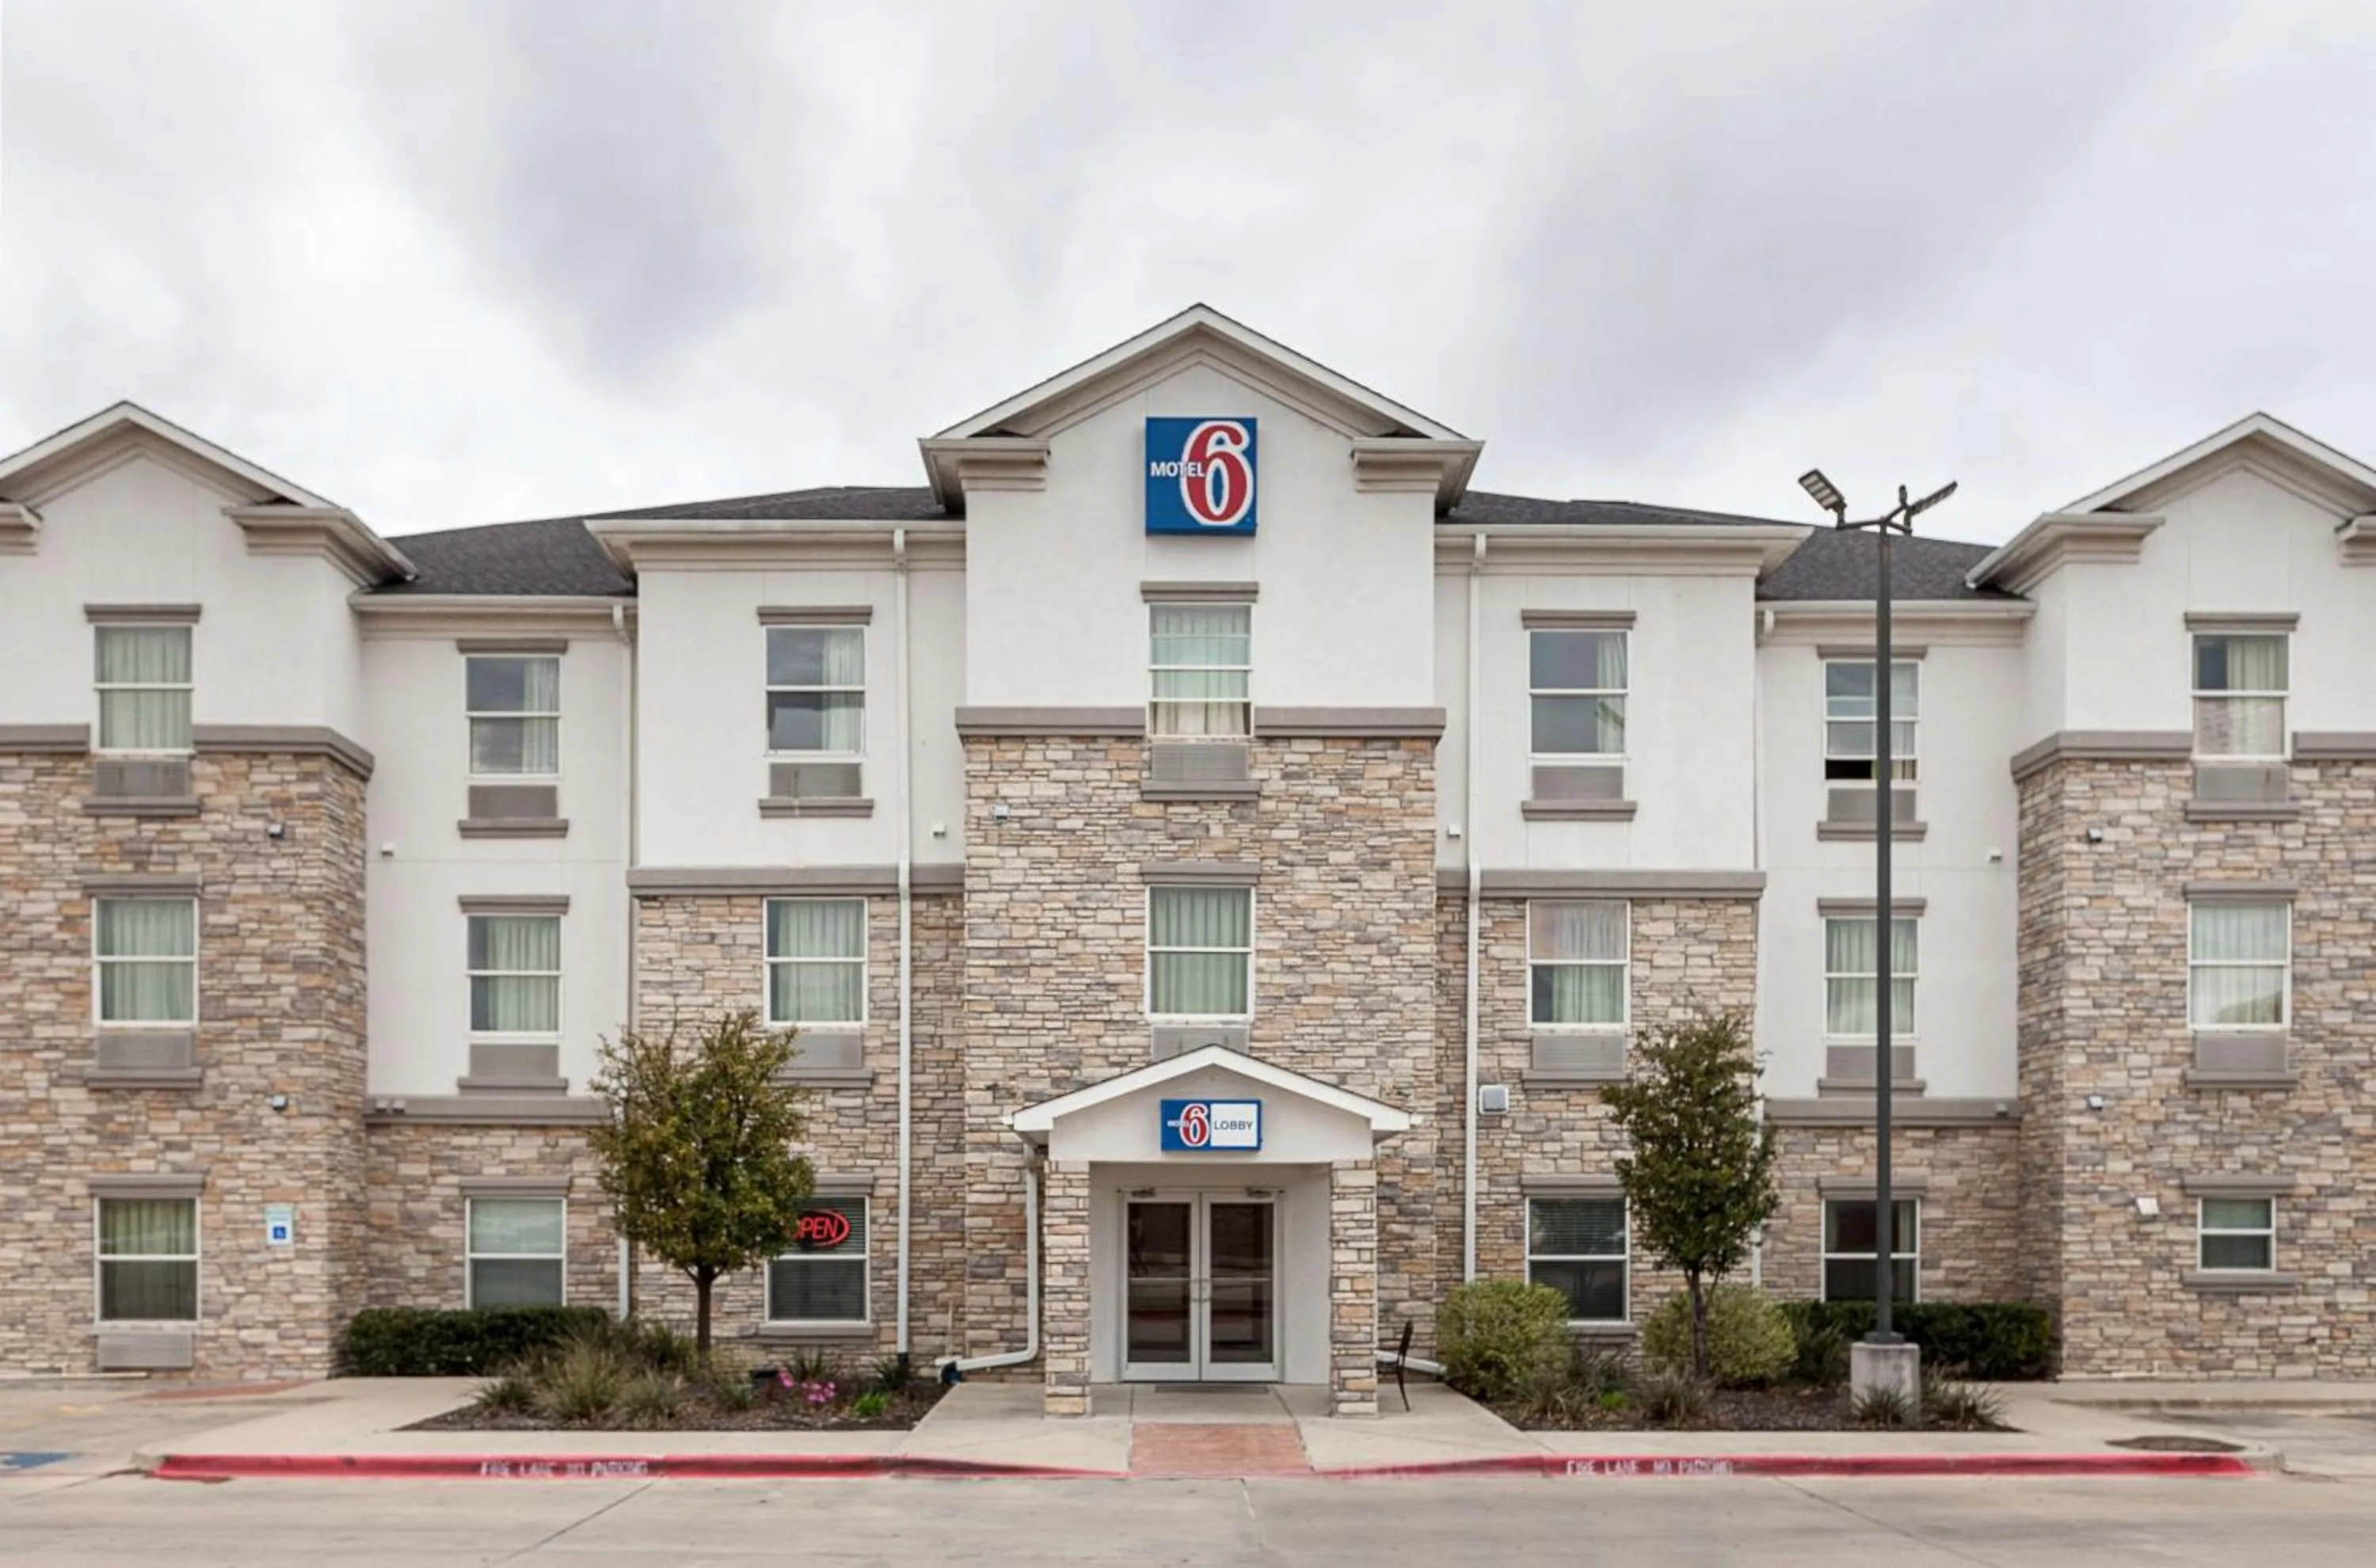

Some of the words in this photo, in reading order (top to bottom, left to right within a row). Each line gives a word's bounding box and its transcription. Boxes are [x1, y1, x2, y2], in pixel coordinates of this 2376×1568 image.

[1150, 462, 1205, 478] MOTEL
[1180, 421, 1254, 526] 6
[1179, 1103, 1209, 1147] 6
[1213, 1121, 1254, 1130] LOBBY
